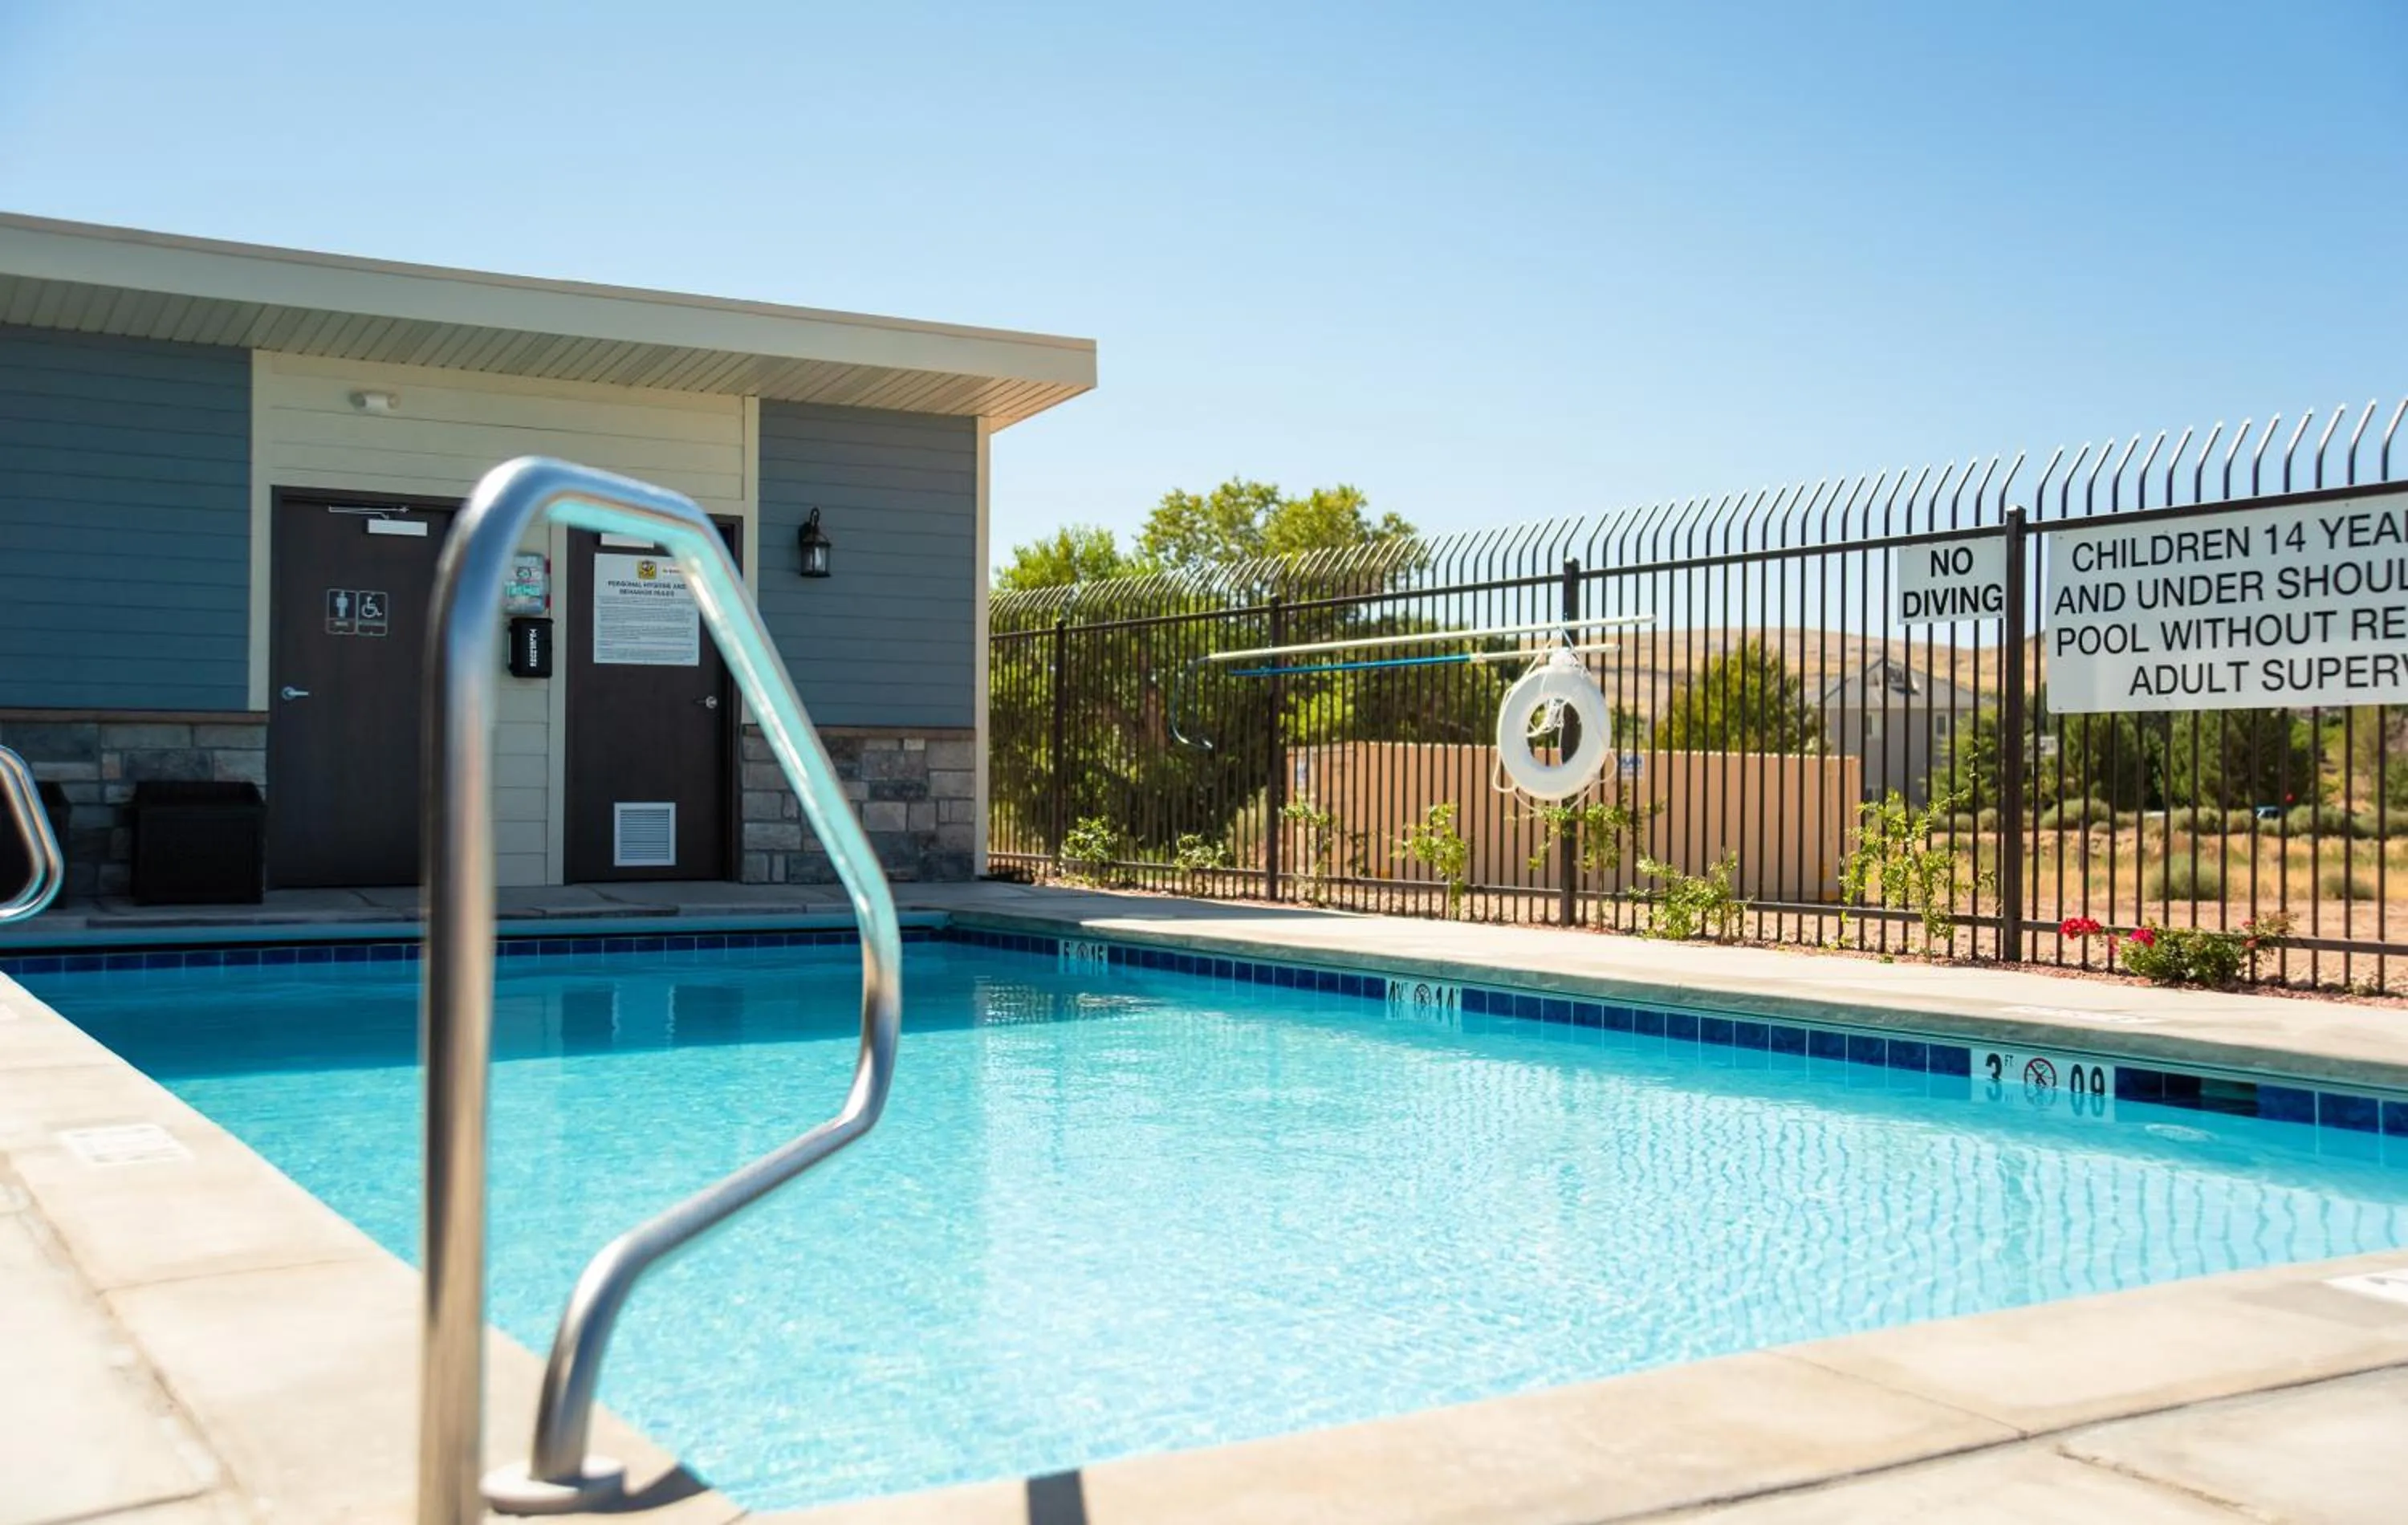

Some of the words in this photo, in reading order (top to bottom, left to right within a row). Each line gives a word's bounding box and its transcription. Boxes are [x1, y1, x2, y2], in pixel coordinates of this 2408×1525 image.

[2072, 526, 2250, 572] CHILDREN
[2264, 521, 2306, 555] 14
[2319, 510, 2408, 549] YEA
[1930, 547, 1974, 577] NO
[1903, 584, 2003, 618] DIVING
[2054, 582, 2126, 616] AND
[2137, 570, 2264, 610] UNDER
[2057, 622, 2150, 657] POOL
[2160, 609, 2337, 651] WITHOUT
[2352, 606, 2406, 641] RE
[2129, 661, 2250, 696] ADULT
[1986, 1052, 2002, 1081] 3
